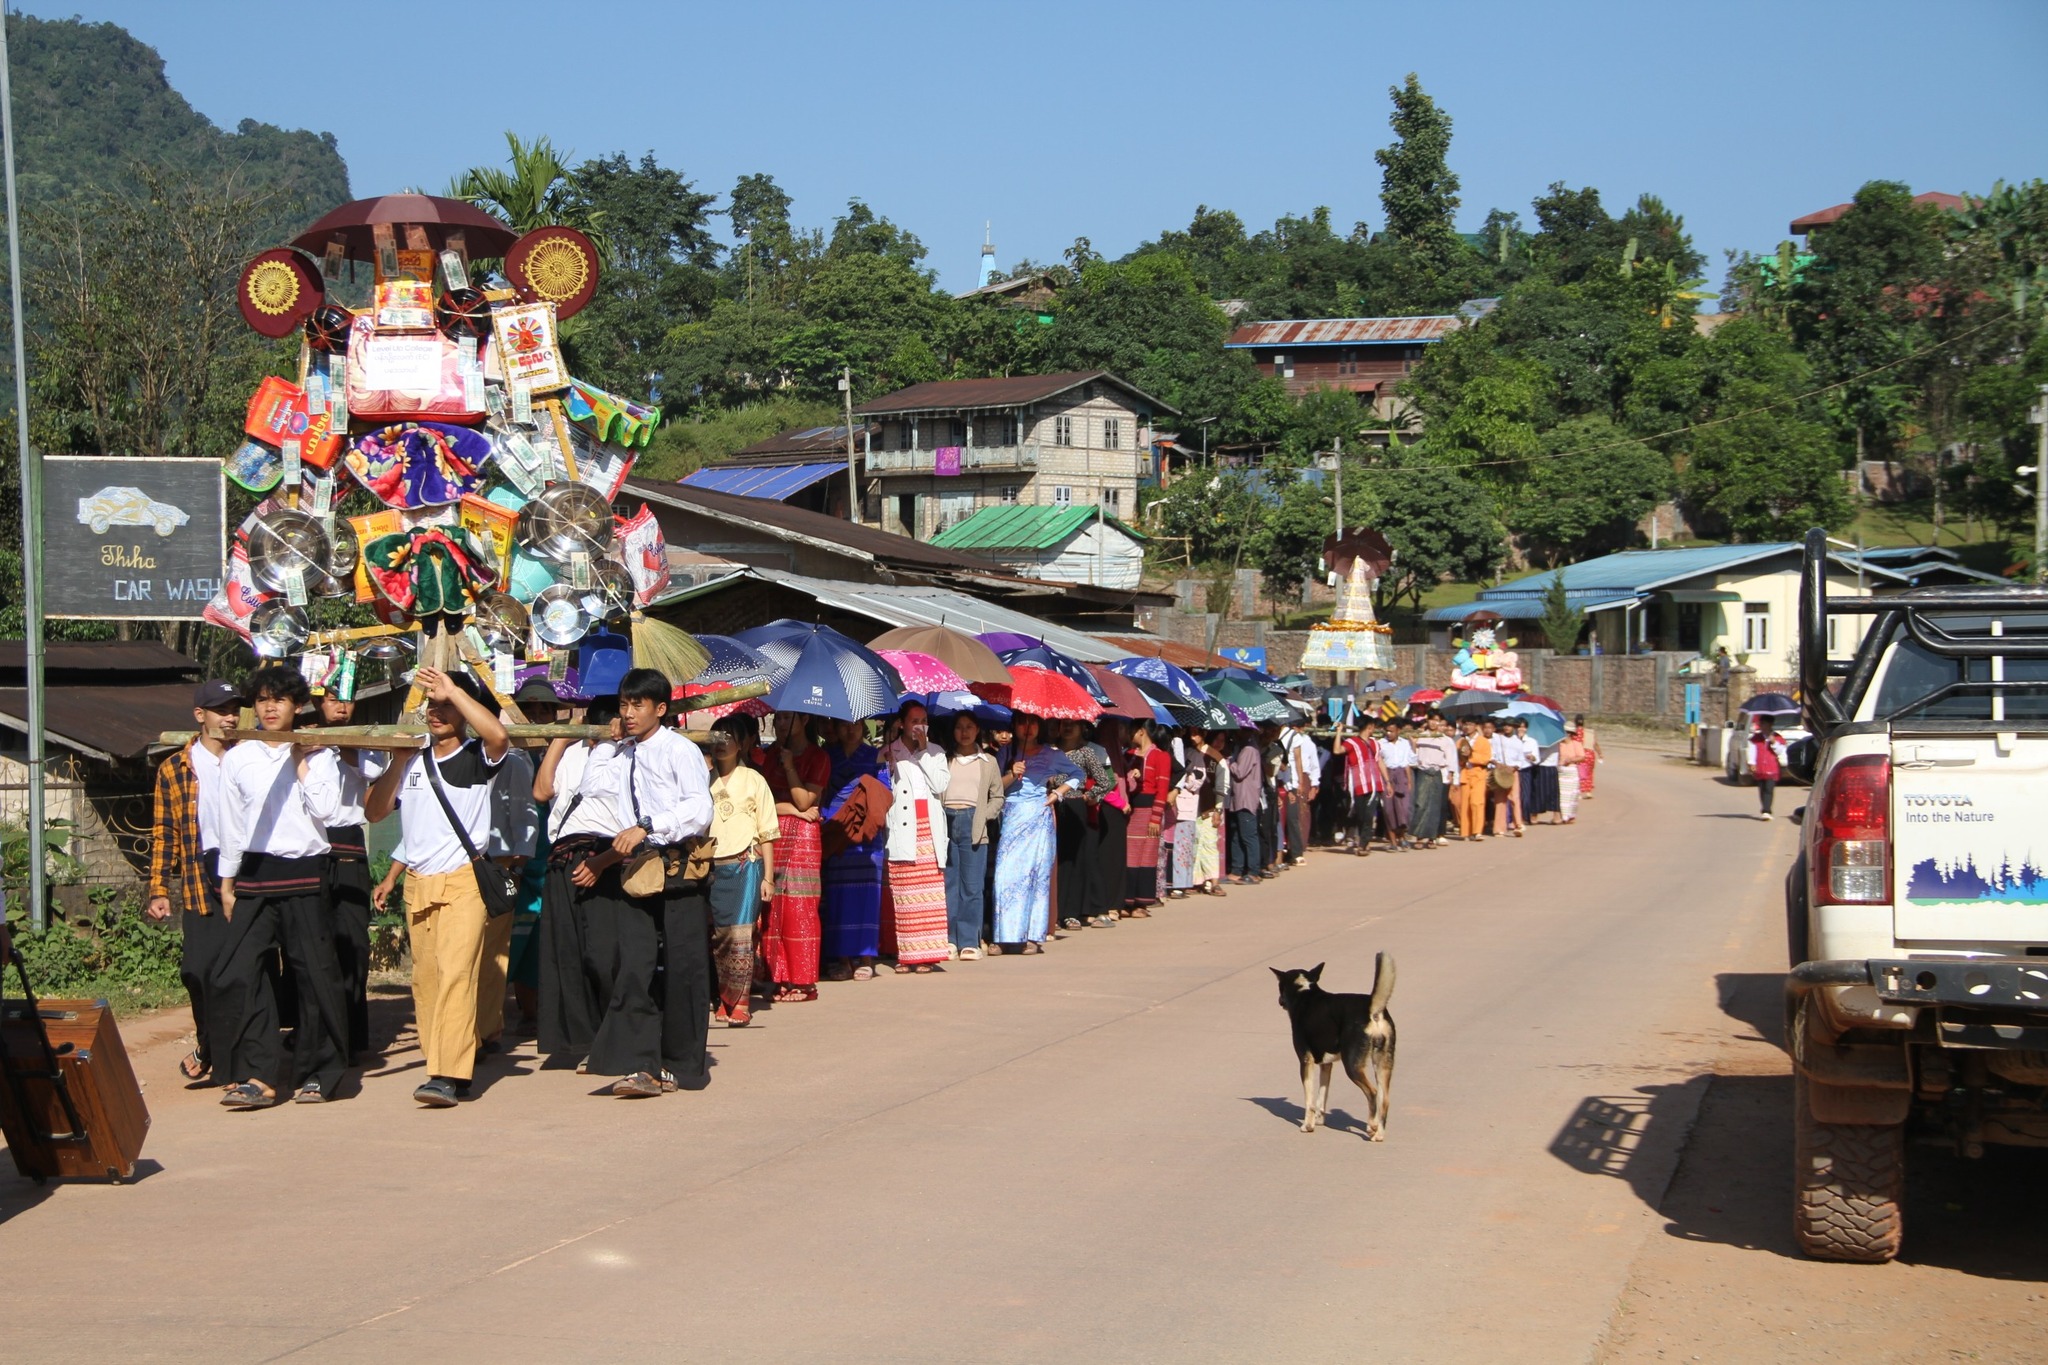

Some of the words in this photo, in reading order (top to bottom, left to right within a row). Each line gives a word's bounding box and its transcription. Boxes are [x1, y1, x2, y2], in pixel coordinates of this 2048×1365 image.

[101, 544, 157, 569] Thiha
[114, 579, 152, 601] CAR
[166, 578, 221, 601] WASH
[1904, 794, 1973, 807] TOYOTA
[1906, 812, 1929, 823] Into
[1932, 812, 1951, 823] the
[1954, 811, 1995, 822] Nature
